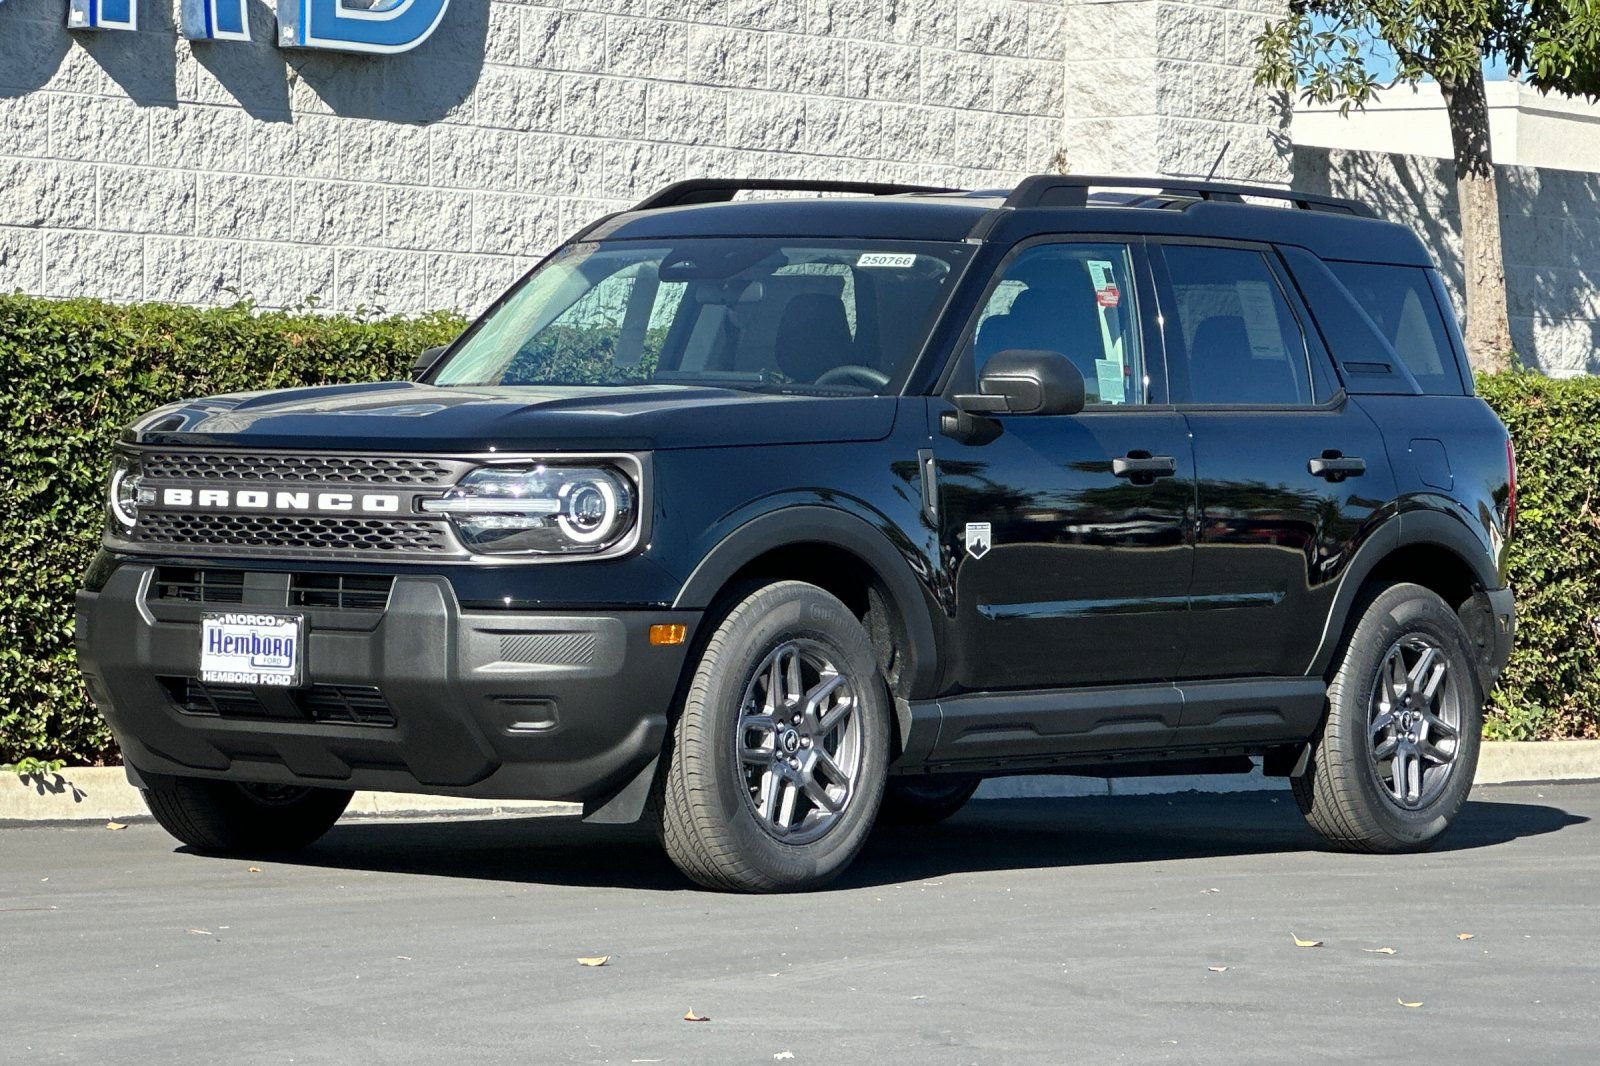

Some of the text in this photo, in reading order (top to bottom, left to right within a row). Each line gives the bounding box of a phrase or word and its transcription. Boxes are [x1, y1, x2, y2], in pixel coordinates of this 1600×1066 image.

[861, 256, 912, 265] 250766
[163, 488, 399, 512] BRONCO
[225, 614, 276, 626] NORCO
[263, 657, 282, 665] FORD
[202, 671, 291, 685] HEMBORG FORD
